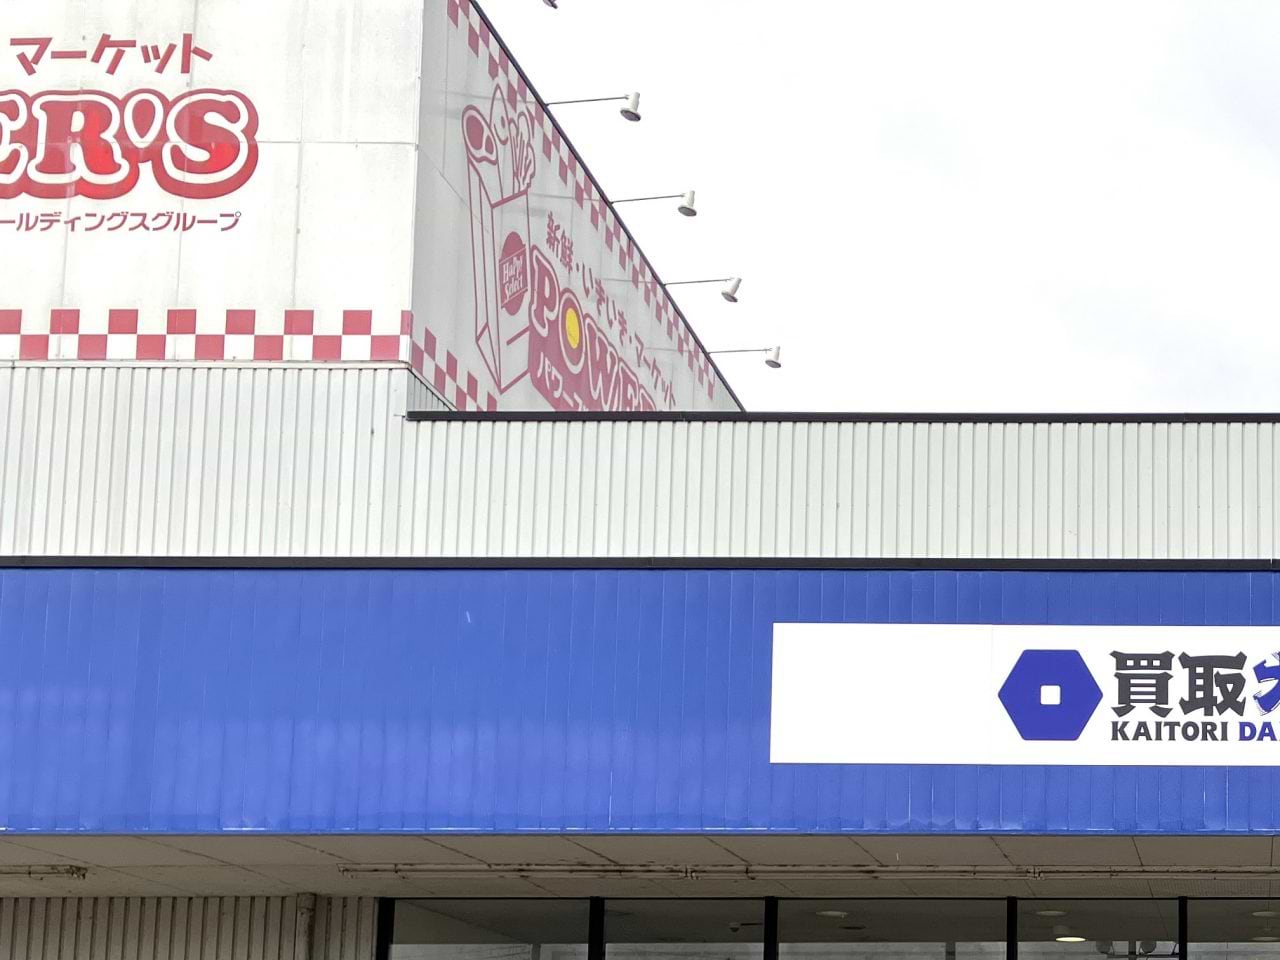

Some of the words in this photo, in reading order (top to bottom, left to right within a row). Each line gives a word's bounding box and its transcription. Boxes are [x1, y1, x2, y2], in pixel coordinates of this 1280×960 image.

[10, 33, 213, 75] マーケット
[1111, 721, 1227, 742] KAITORI
